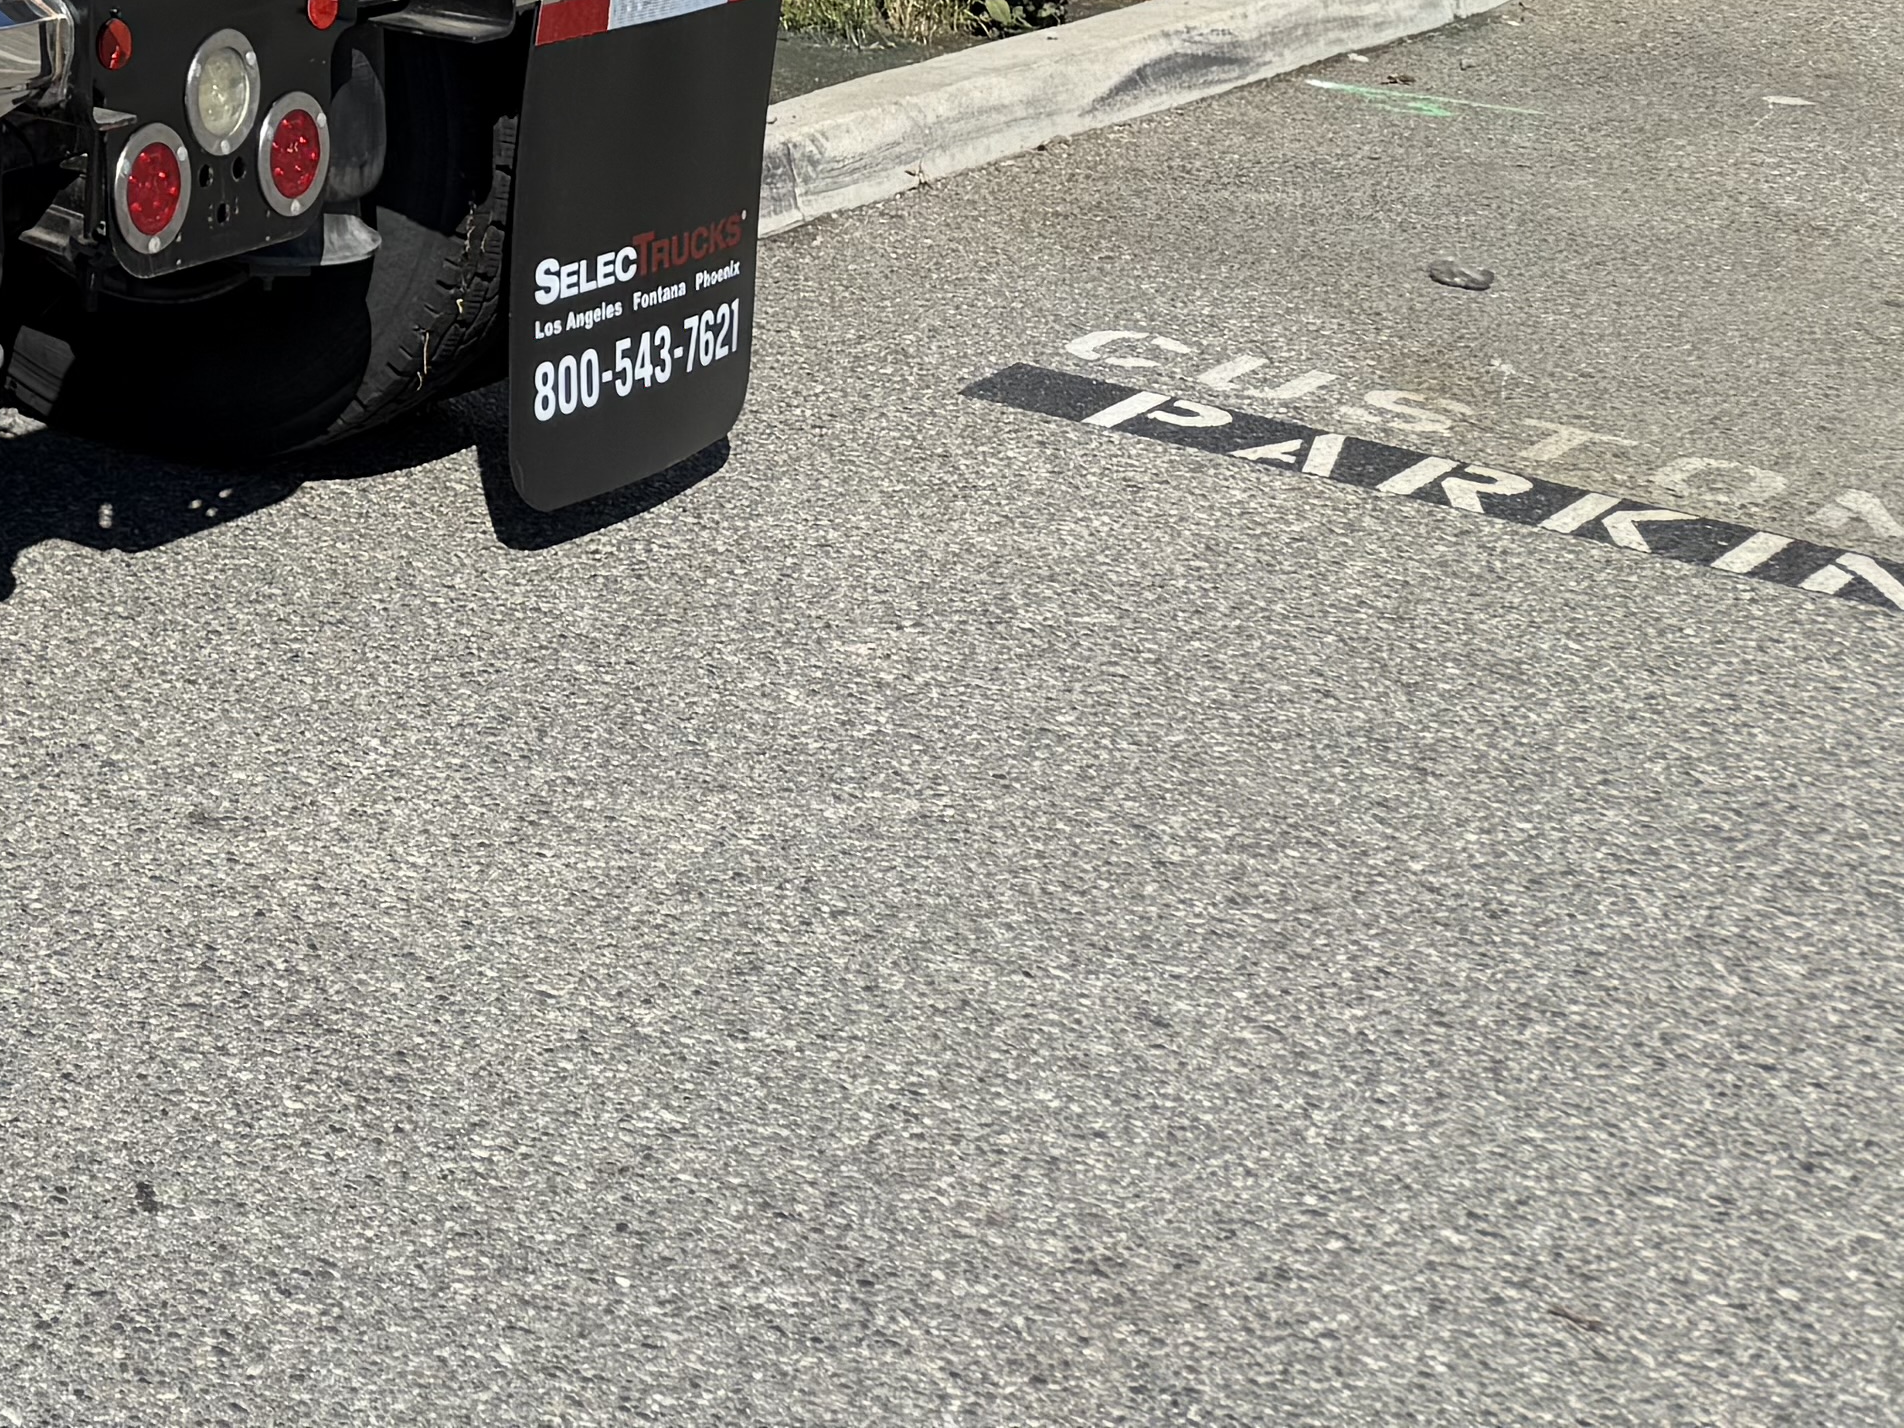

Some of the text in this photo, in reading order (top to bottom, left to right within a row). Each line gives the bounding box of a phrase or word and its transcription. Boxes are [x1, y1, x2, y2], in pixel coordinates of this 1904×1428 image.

[534, 260, 740, 340] Los Angeles Fontana Phoenix
[534, 298, 740, 422] 800-543-7621
